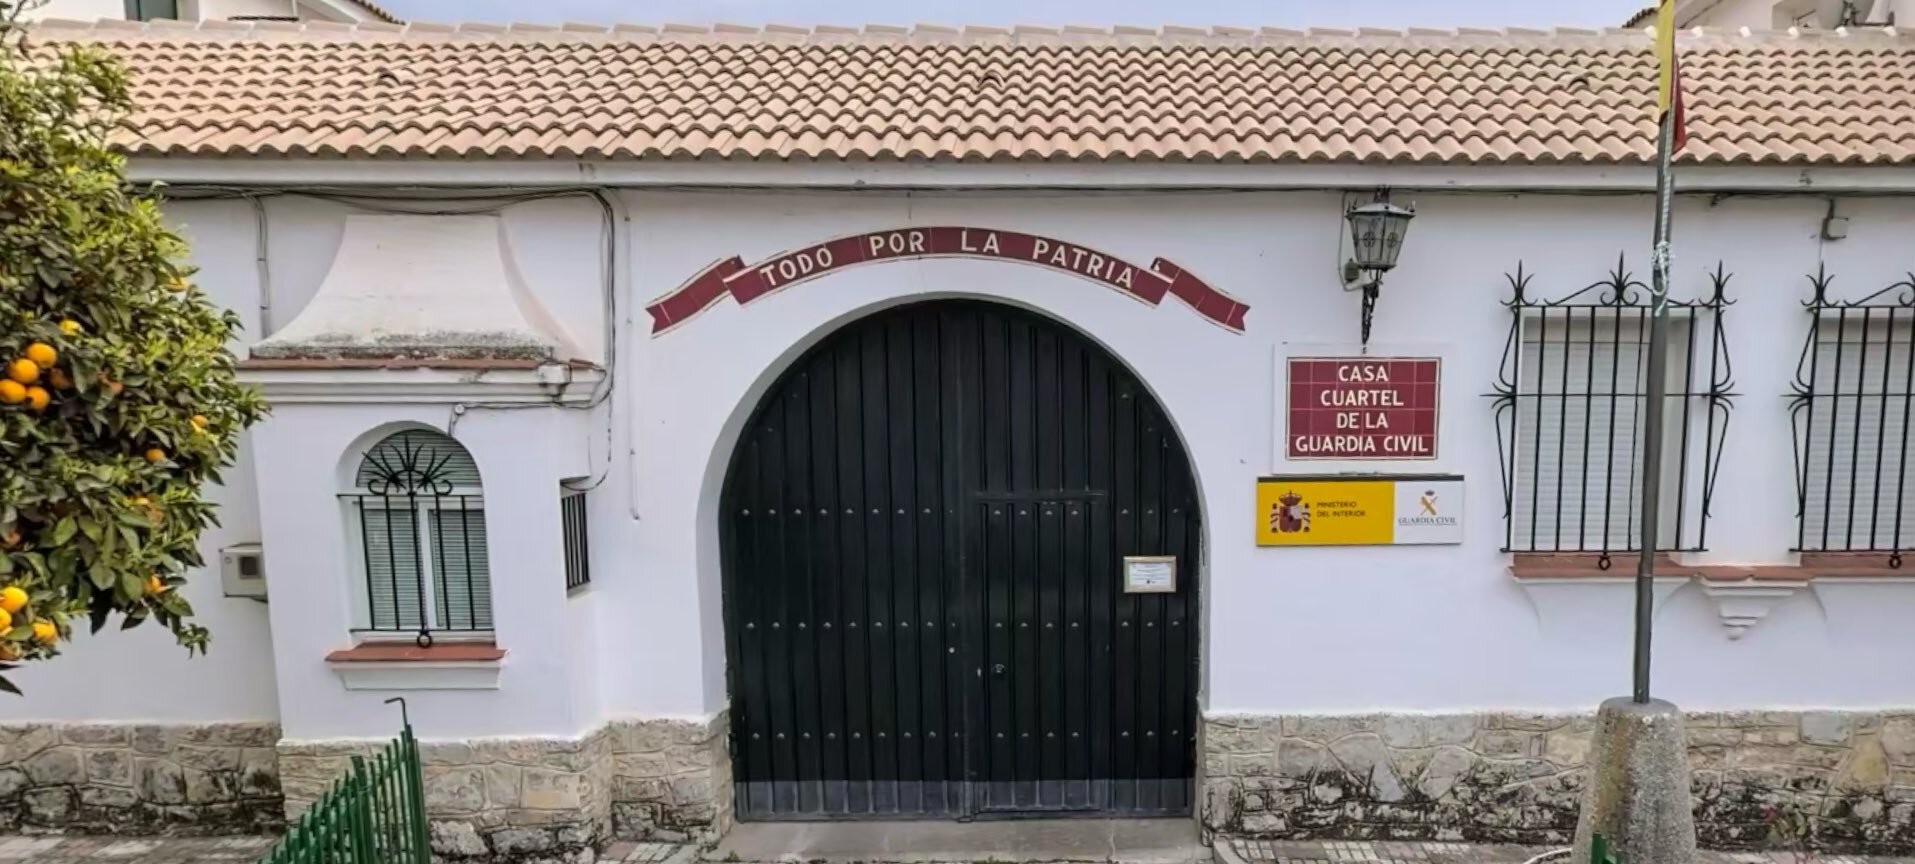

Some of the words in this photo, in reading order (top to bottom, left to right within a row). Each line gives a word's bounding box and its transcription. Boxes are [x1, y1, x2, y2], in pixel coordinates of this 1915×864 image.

[760, 247, 833, 288] TODO
[869, 231, 924, 257] POR
[961, 231, 1001, 254] LA
[1032, 240, 1134, 289] PATRIA
[1338, 365, 1389, 382] CASA
[1320, 389, 1404, 406] CUARTEL
[1336, 412, 1360, 429] DE
[1365, 412, 1389, 429] LA
[1295, 435, 1376, 452] GUARDIA
[1383, 436, 1428, 452] CIVIL
[1332, 510, 1366, 518] INTERIOR
